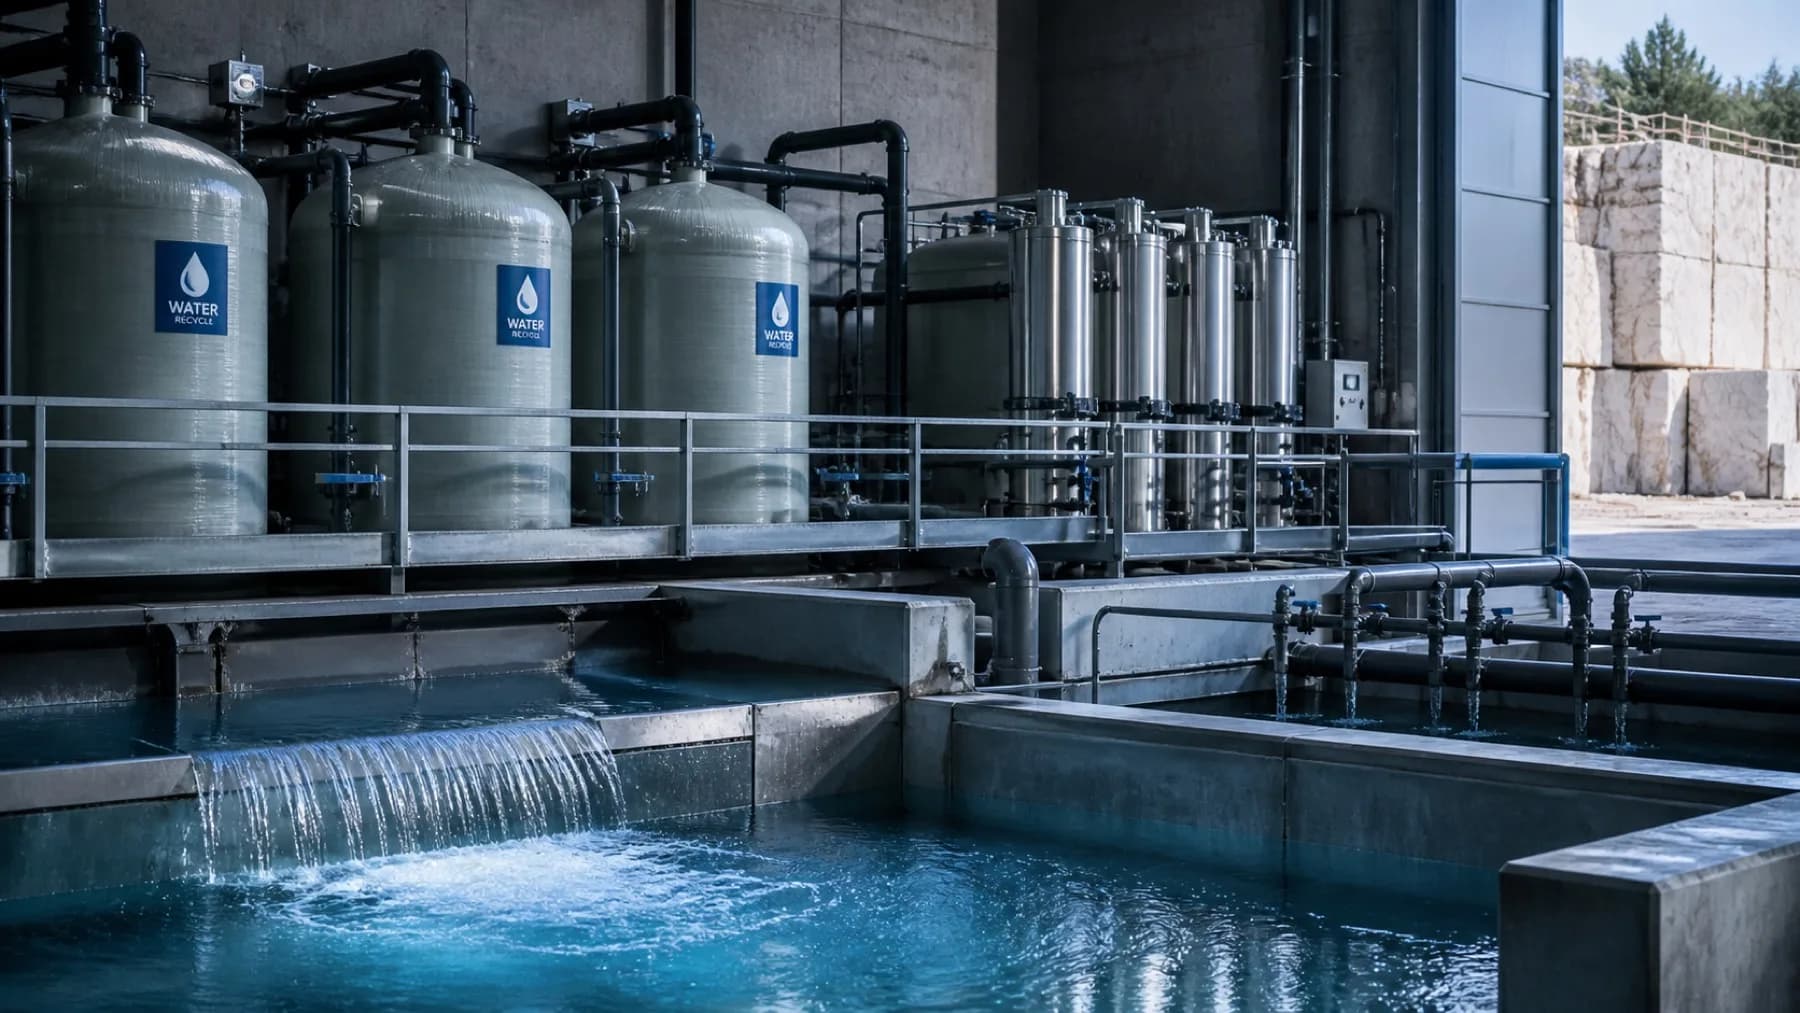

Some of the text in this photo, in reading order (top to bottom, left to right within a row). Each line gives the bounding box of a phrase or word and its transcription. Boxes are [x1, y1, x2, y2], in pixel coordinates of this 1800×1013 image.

[168, 300, 219, 316] WATER
[507, 317, 545, 331] WATER
[764, 329, 794, 341] WATER
